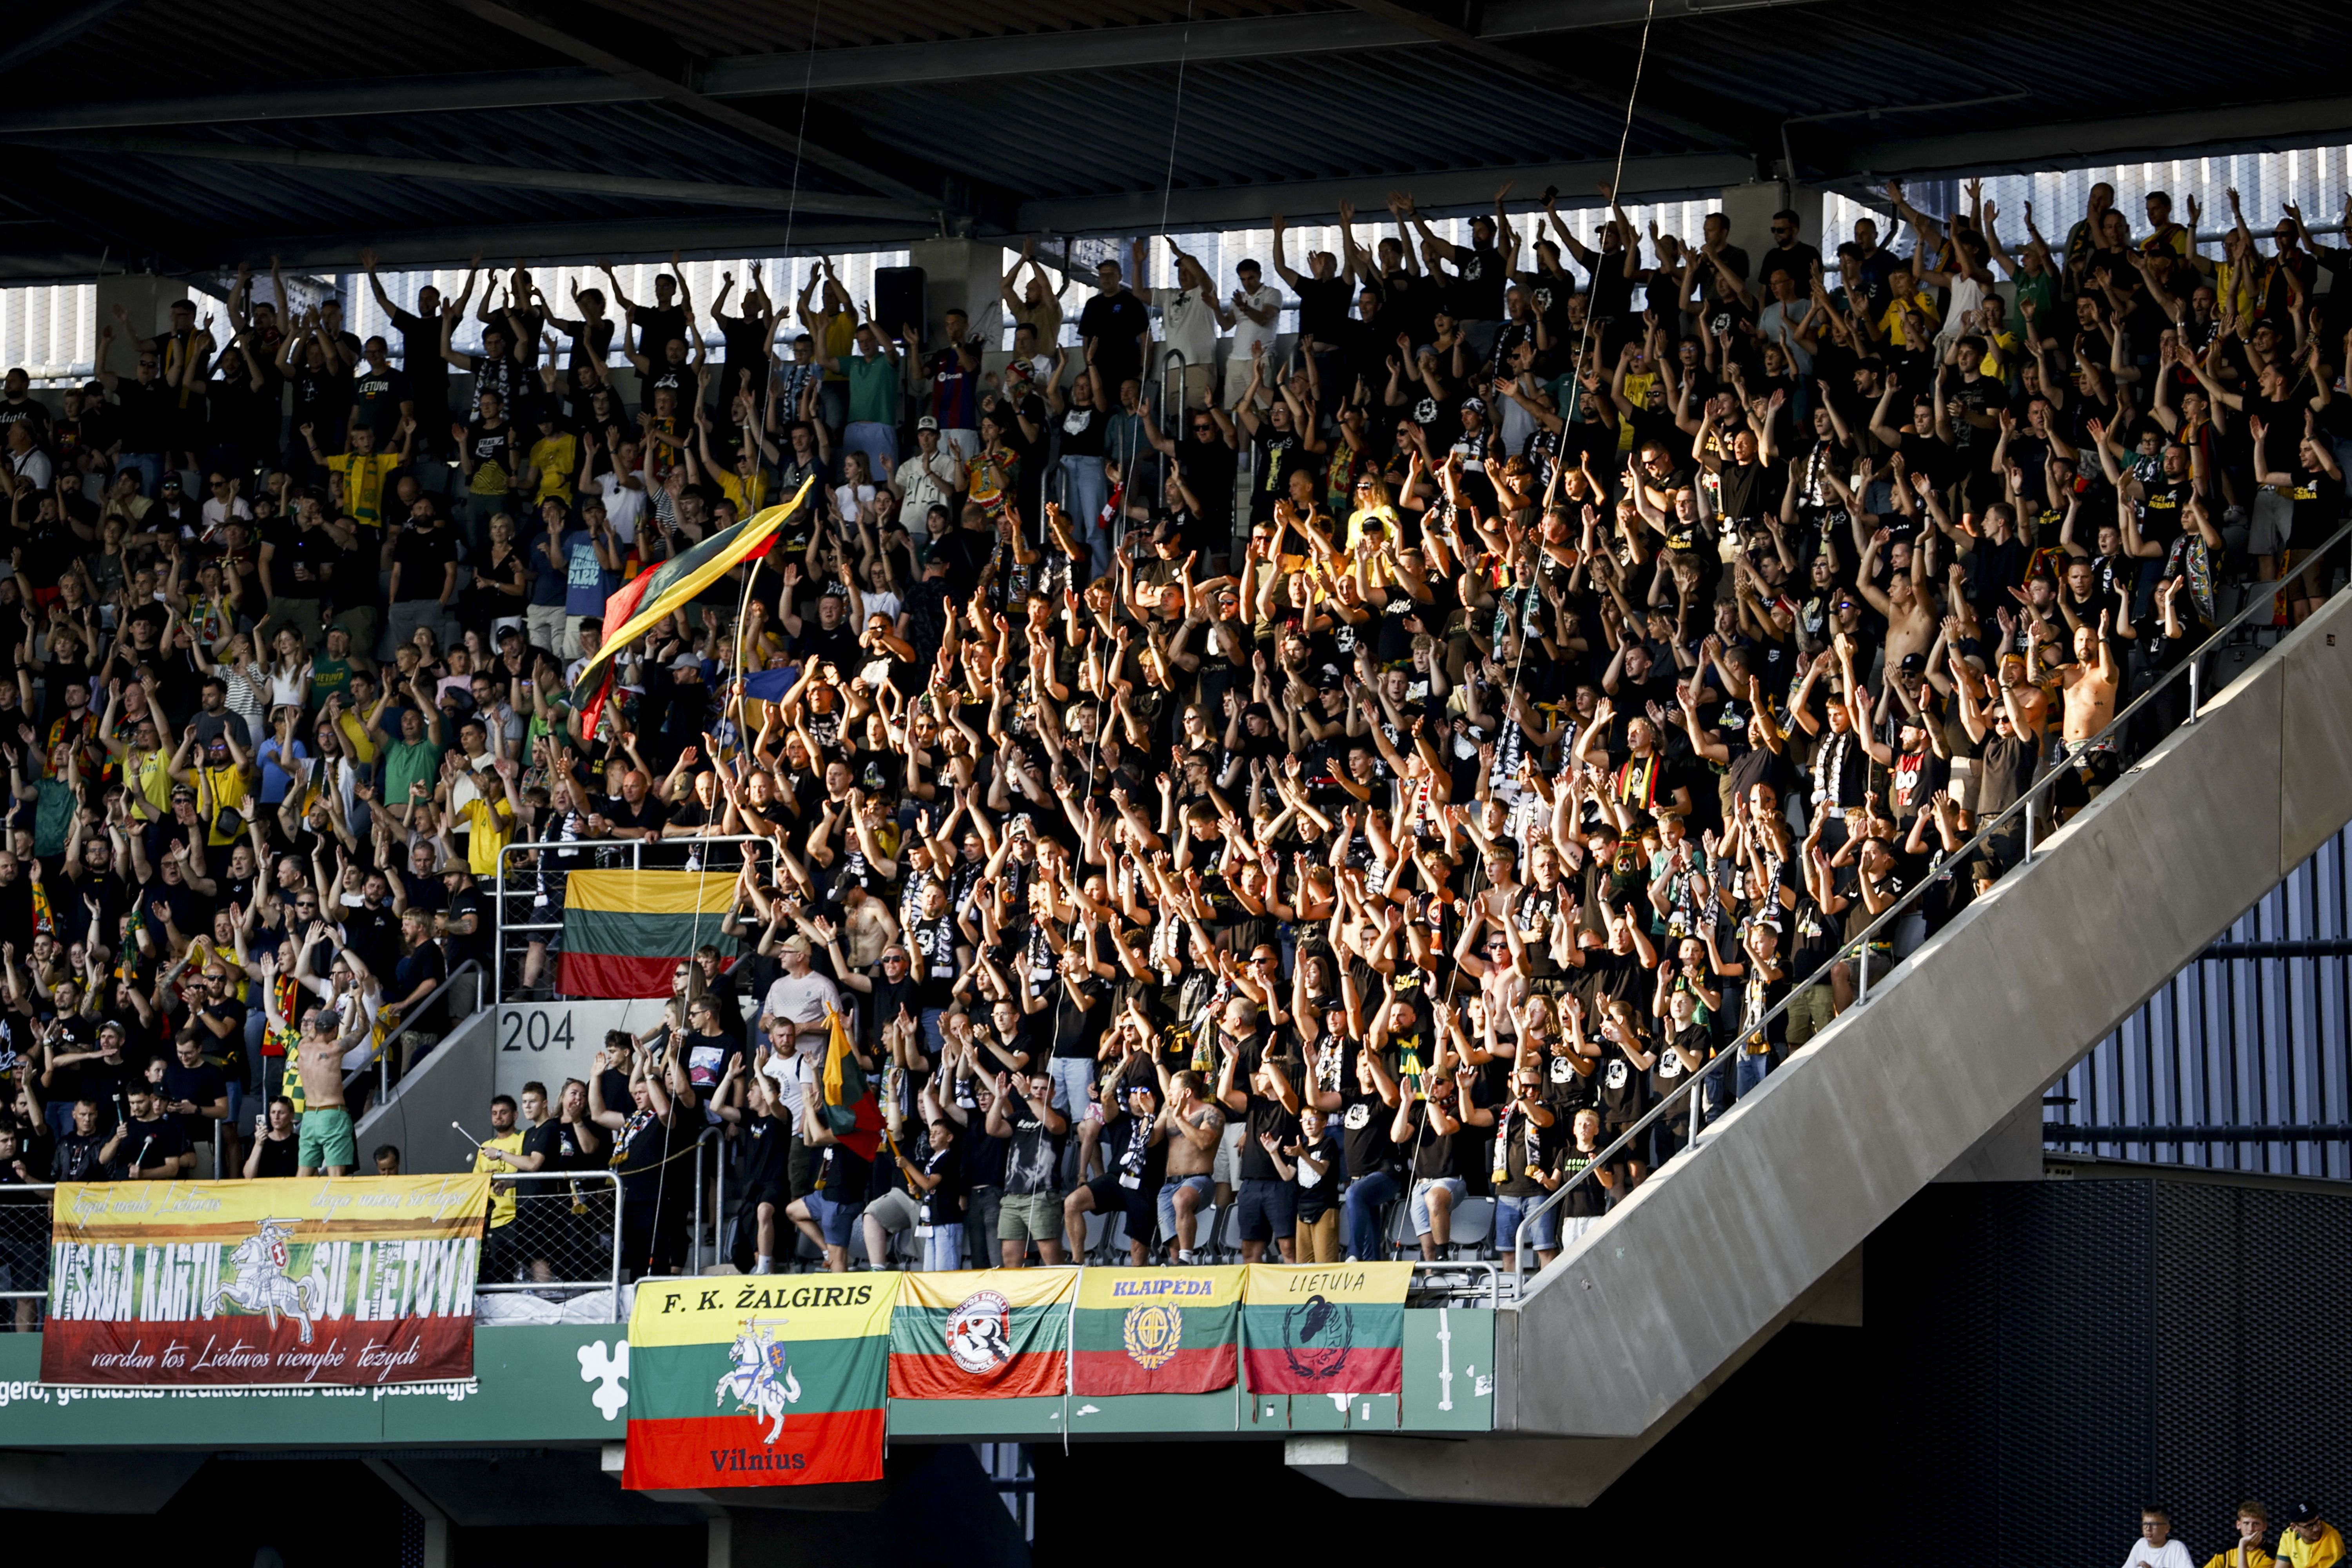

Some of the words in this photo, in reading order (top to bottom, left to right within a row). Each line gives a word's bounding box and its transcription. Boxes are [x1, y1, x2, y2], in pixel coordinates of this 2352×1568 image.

[568, 569, 599, 586] PARK
[502, 1010, 574, 1052] 204
[154, 1181, 221, 1217] Lietuvos
[310, 1178, 353, 1223] dega
[406, 1177, 468, 1223] širdyse
[140, 1242, 222, 1322] KARTU
[311, 1241, 351, 1321] SU
[355, 1237, 476, 1321] LIETUVA
[1289, 1272, 1365, 1292] LIETUVA
[661, 1294, 686, 1314] F.
[697, 1289, 724, 1310] K.
[735, 1284, 873, 1309] ŽALGIRIS
[92, 1339, 156, 1368] vardan
[161, 1339, 190, 1368] tos
[190, 1334, 270, 1372] Lietuvos
[277, 1338, 347, 1383] vienybė
[357, 1335, 421, 1382] težydi
[710, 1448, 806, 1472] Vilnius
